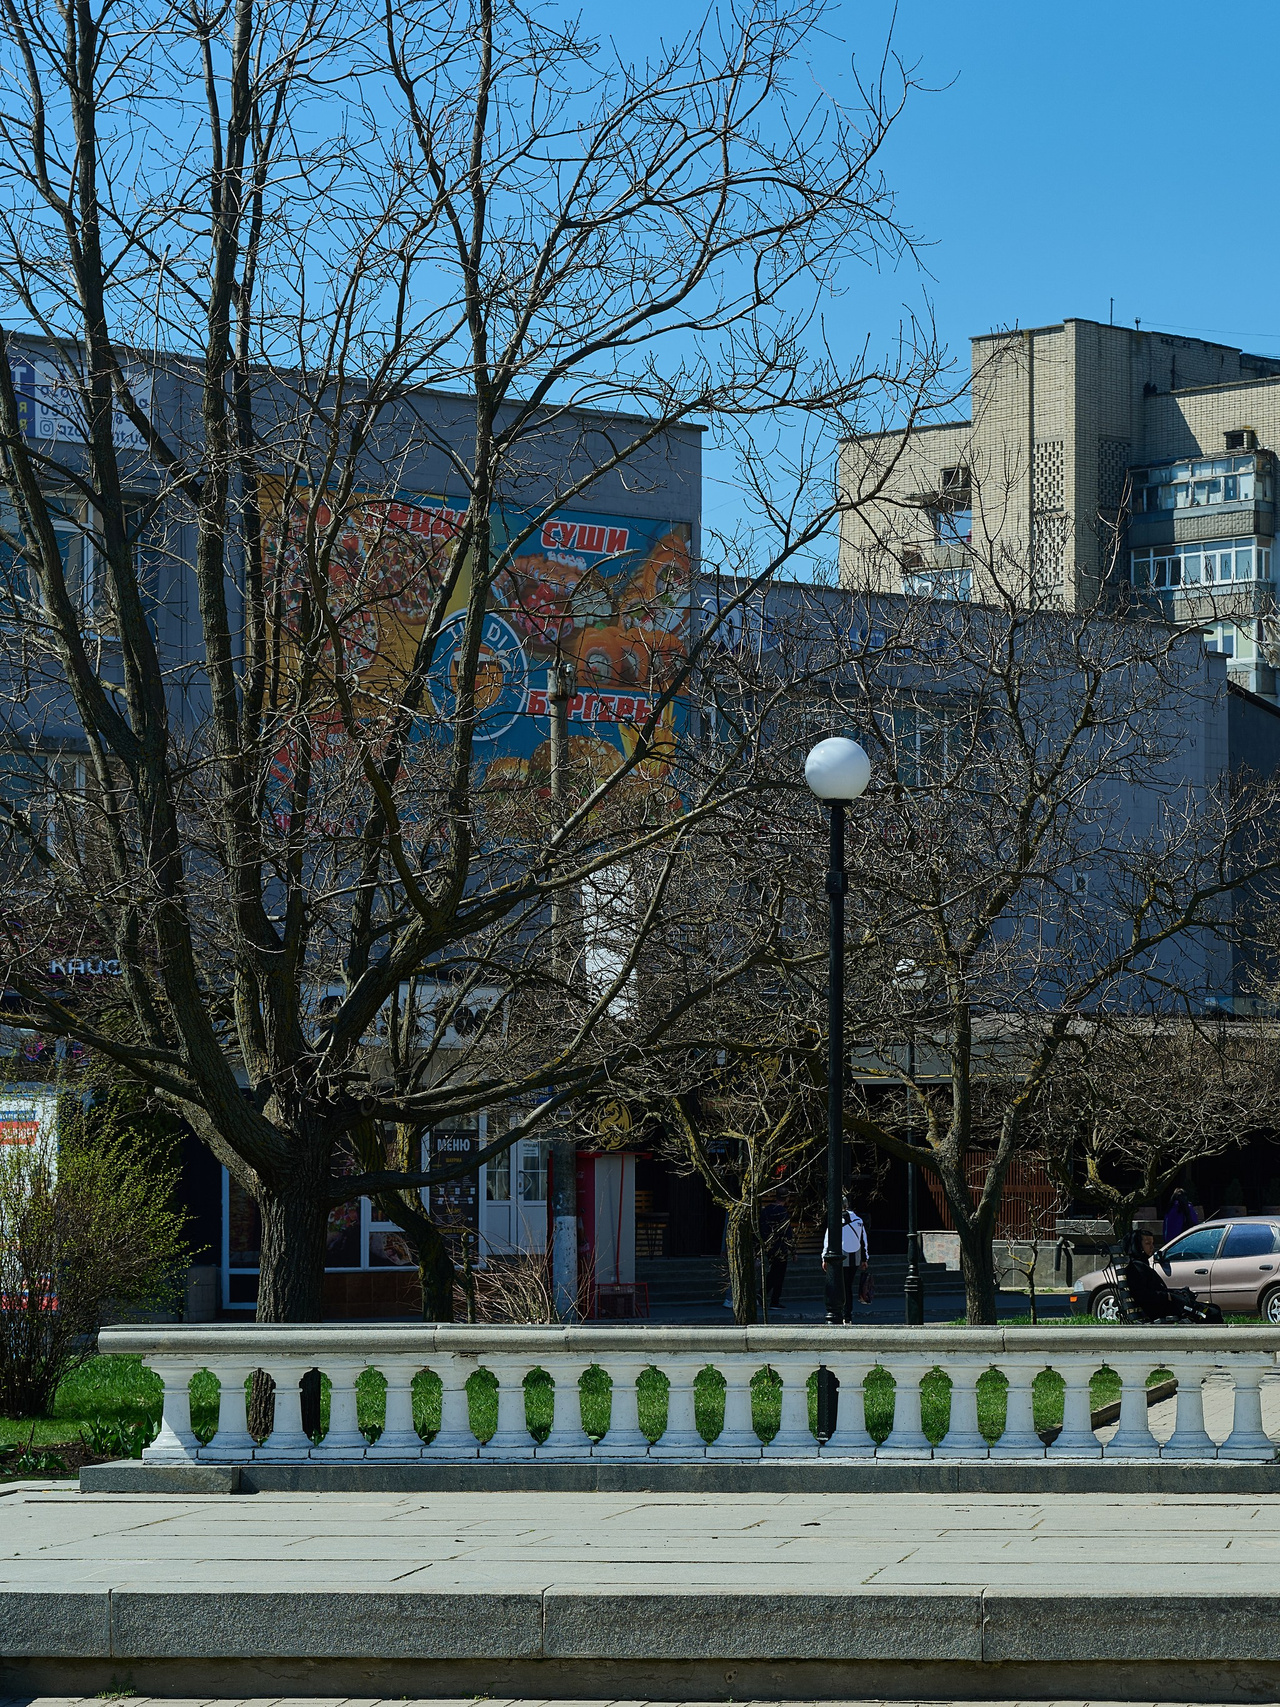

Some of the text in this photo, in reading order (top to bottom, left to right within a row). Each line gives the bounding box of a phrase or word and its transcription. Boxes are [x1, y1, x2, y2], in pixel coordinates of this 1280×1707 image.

[541, 520, 630, 555] СУШИ
[525, 688, 664, 727] БРГЕРЫ
[437, 1138, 471, 1152] МЕНЮ
